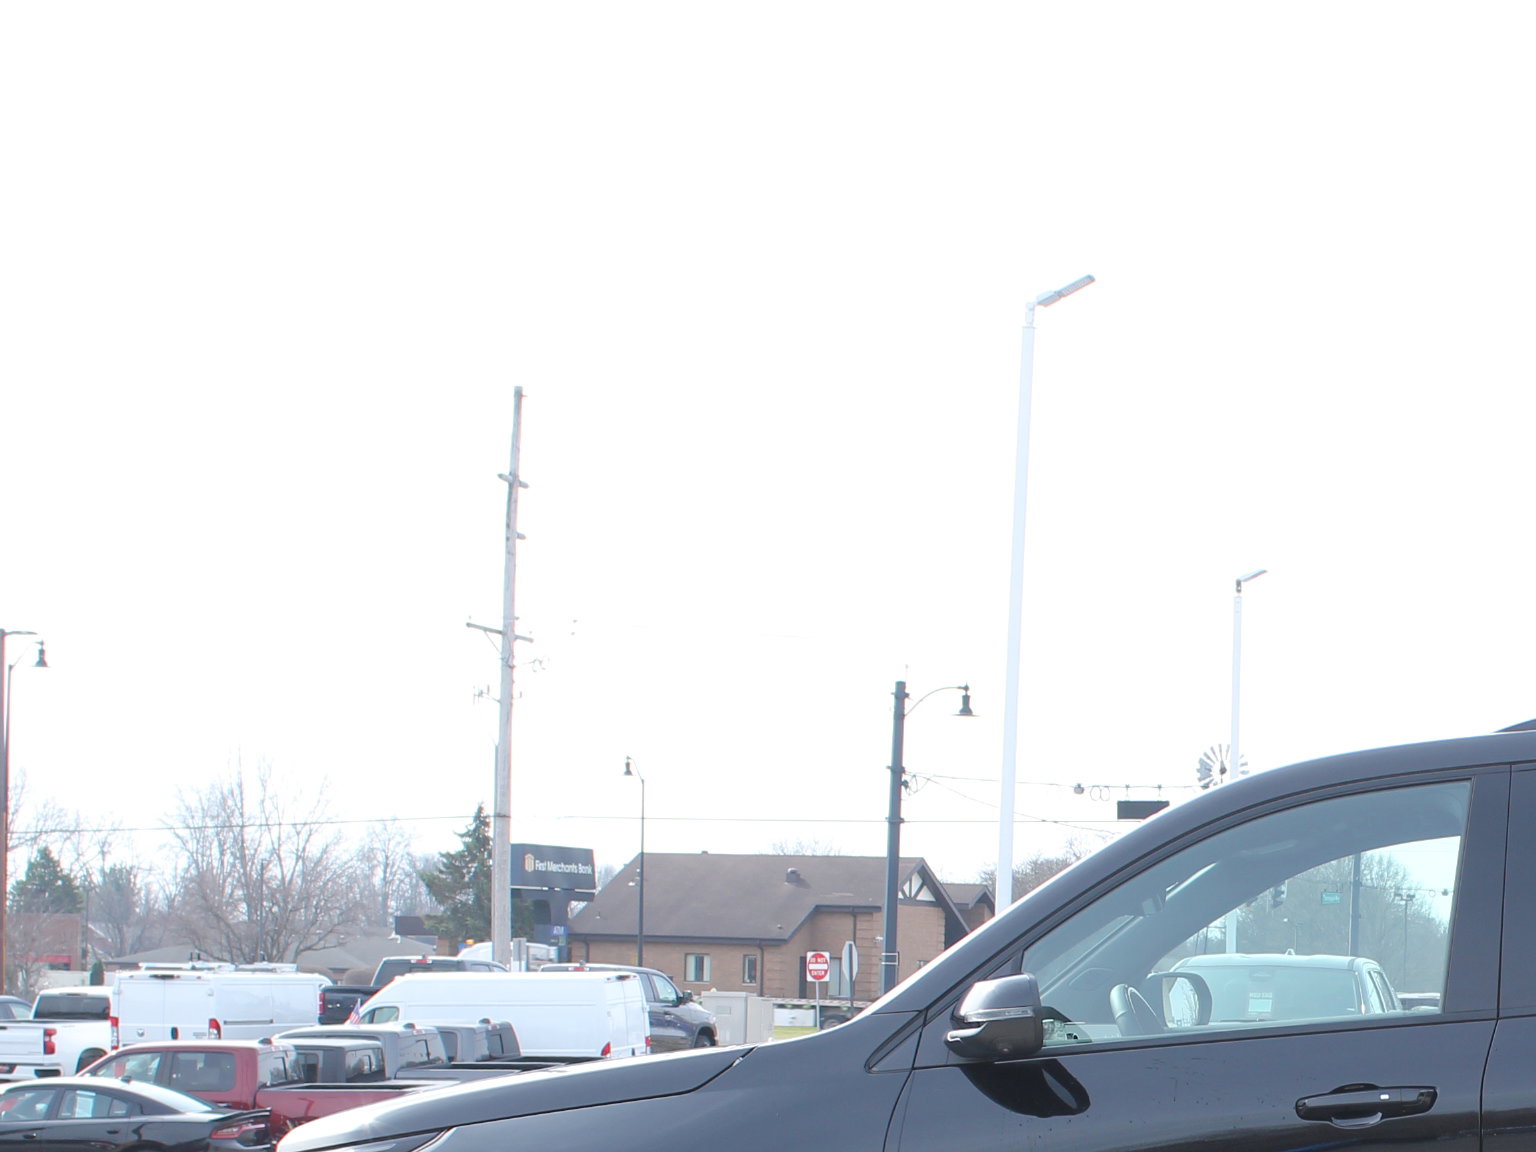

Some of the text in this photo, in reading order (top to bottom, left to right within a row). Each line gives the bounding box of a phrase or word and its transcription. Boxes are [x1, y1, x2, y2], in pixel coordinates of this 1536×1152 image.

[535, 860, 592, 875] First Merchants Bank
